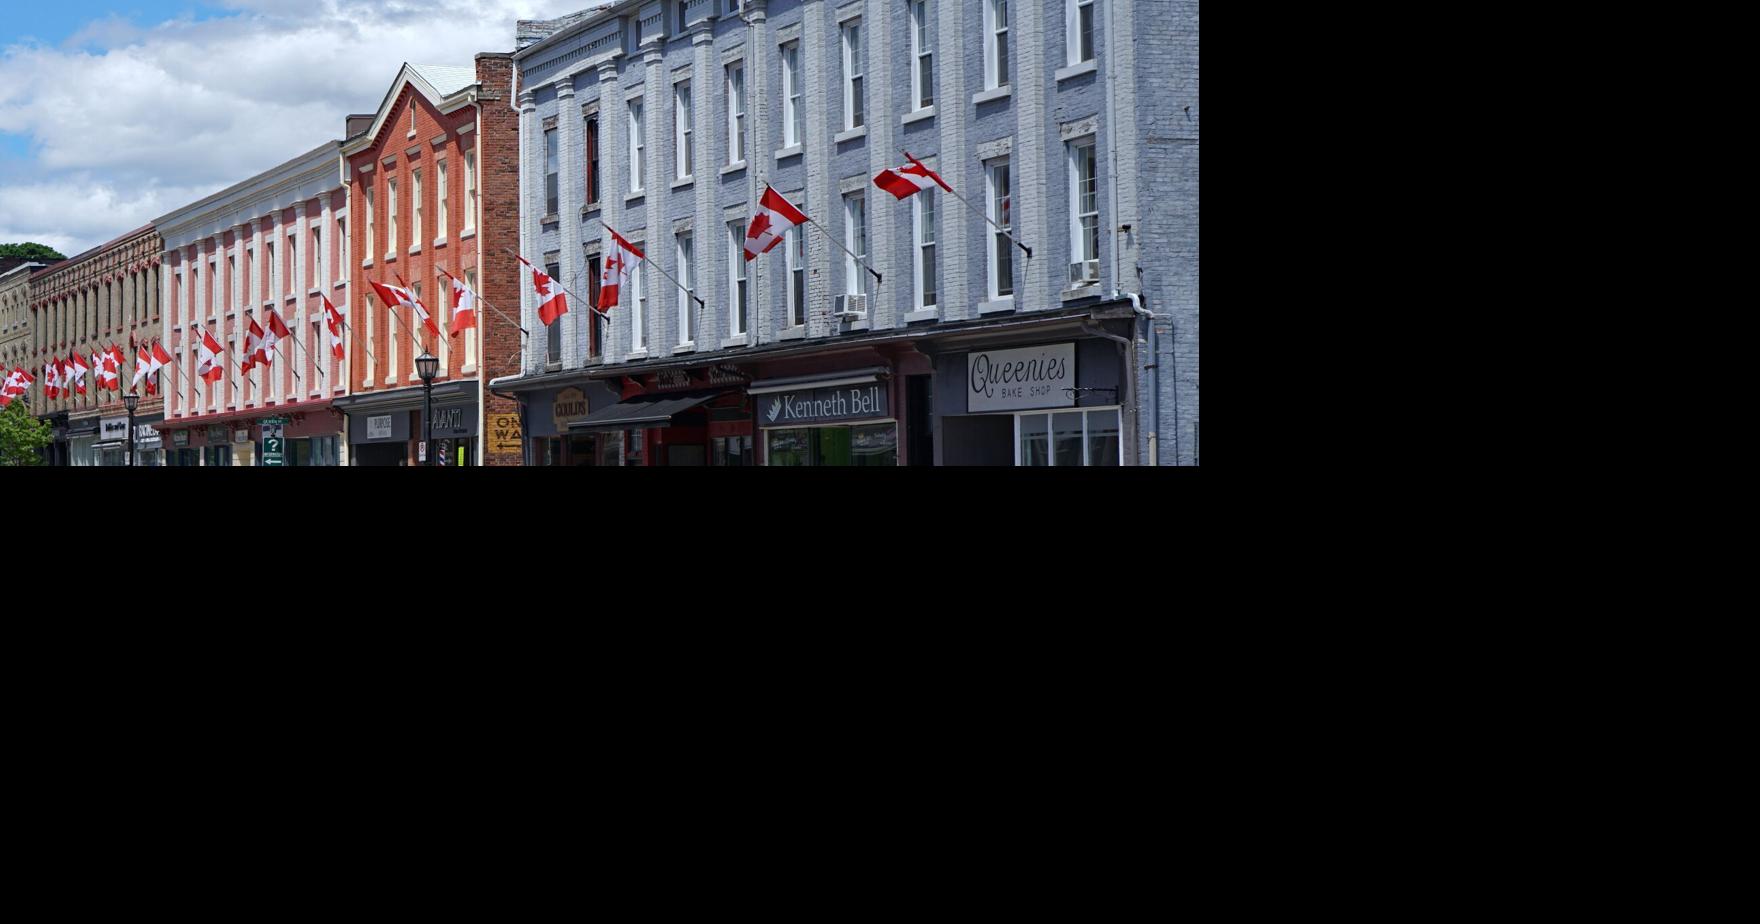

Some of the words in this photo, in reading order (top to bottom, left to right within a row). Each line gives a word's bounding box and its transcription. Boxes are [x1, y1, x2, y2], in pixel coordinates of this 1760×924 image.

[971, 353, 1065, 398] Queenies
[784, 391, 847, 418] Kenneth
[850, 387, 880, 414] Bell
[1002, 387, 1022, 399] BAKE
[1030, 385, 1051, 397] SHOP
